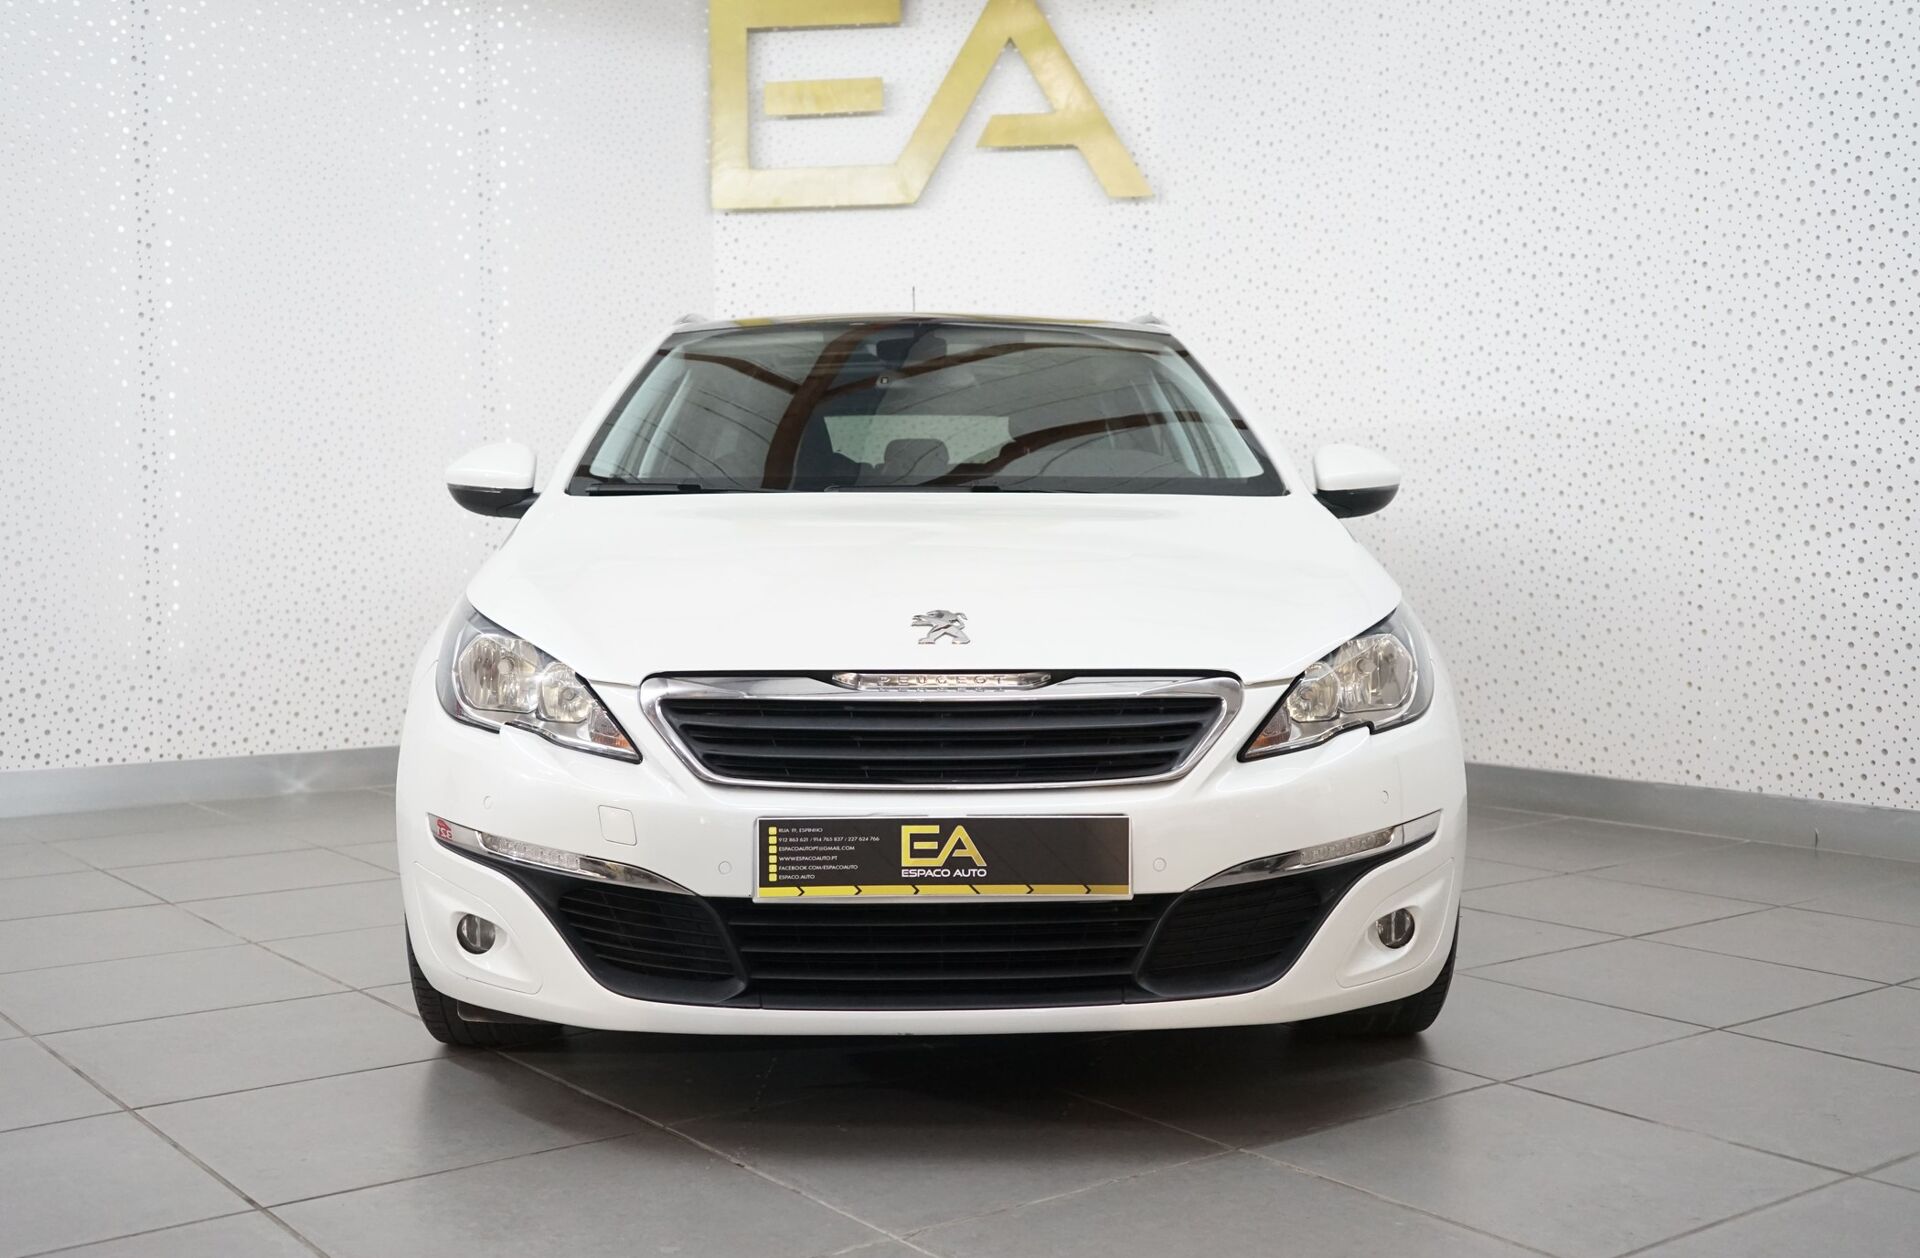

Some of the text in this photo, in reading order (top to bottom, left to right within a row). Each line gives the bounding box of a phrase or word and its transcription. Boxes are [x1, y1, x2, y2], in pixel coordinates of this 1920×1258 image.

[709, 0, 1155, 211] EA
[878, 675, 1007, 686] PEUGEOT
[901, 825, 987, 867] EA
[901, 868, 987, 878] ESPACO AUTO
